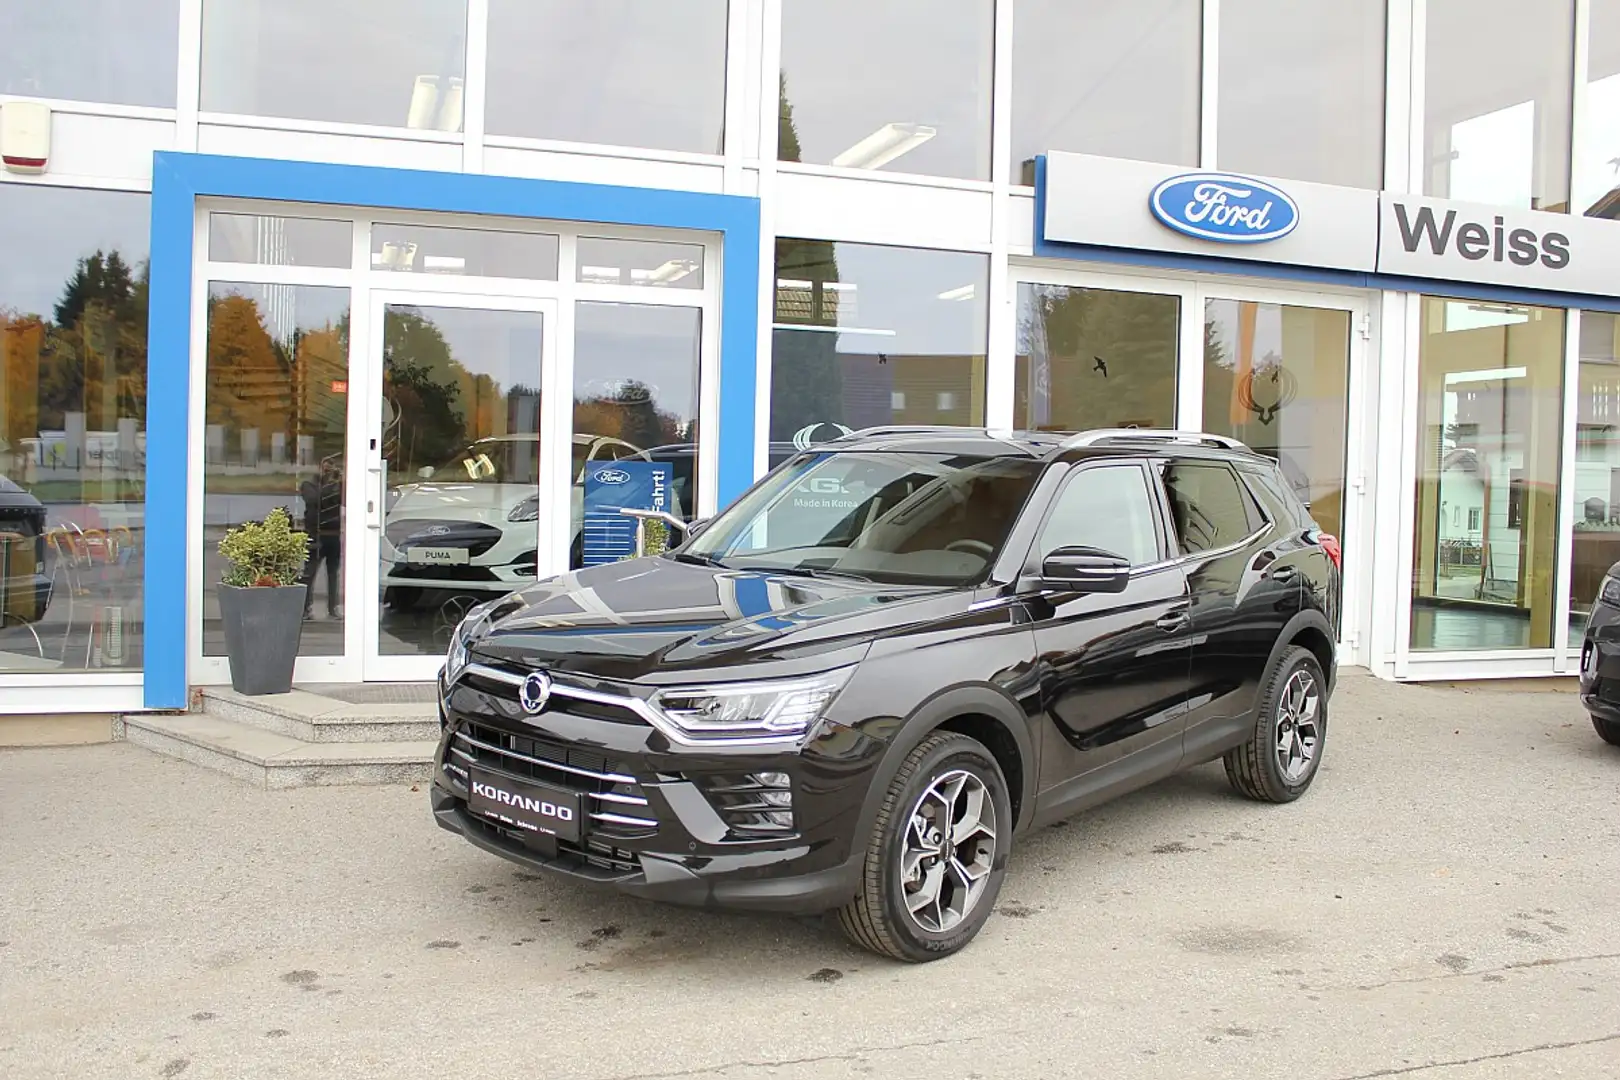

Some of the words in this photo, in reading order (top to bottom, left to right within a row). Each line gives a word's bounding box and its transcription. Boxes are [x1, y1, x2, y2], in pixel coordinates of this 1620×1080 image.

[1184, 183, 1273, 230] Ford
[1393, 203, 1571, 269] Weiss
[600, 470, 624, 482] Ford
[793, 498, 820, 508] Made
[831, 499, 859, 508] Korea
[425, 551, 451, 559] PUMA
[472, 781, 573, 821] KORANDO
